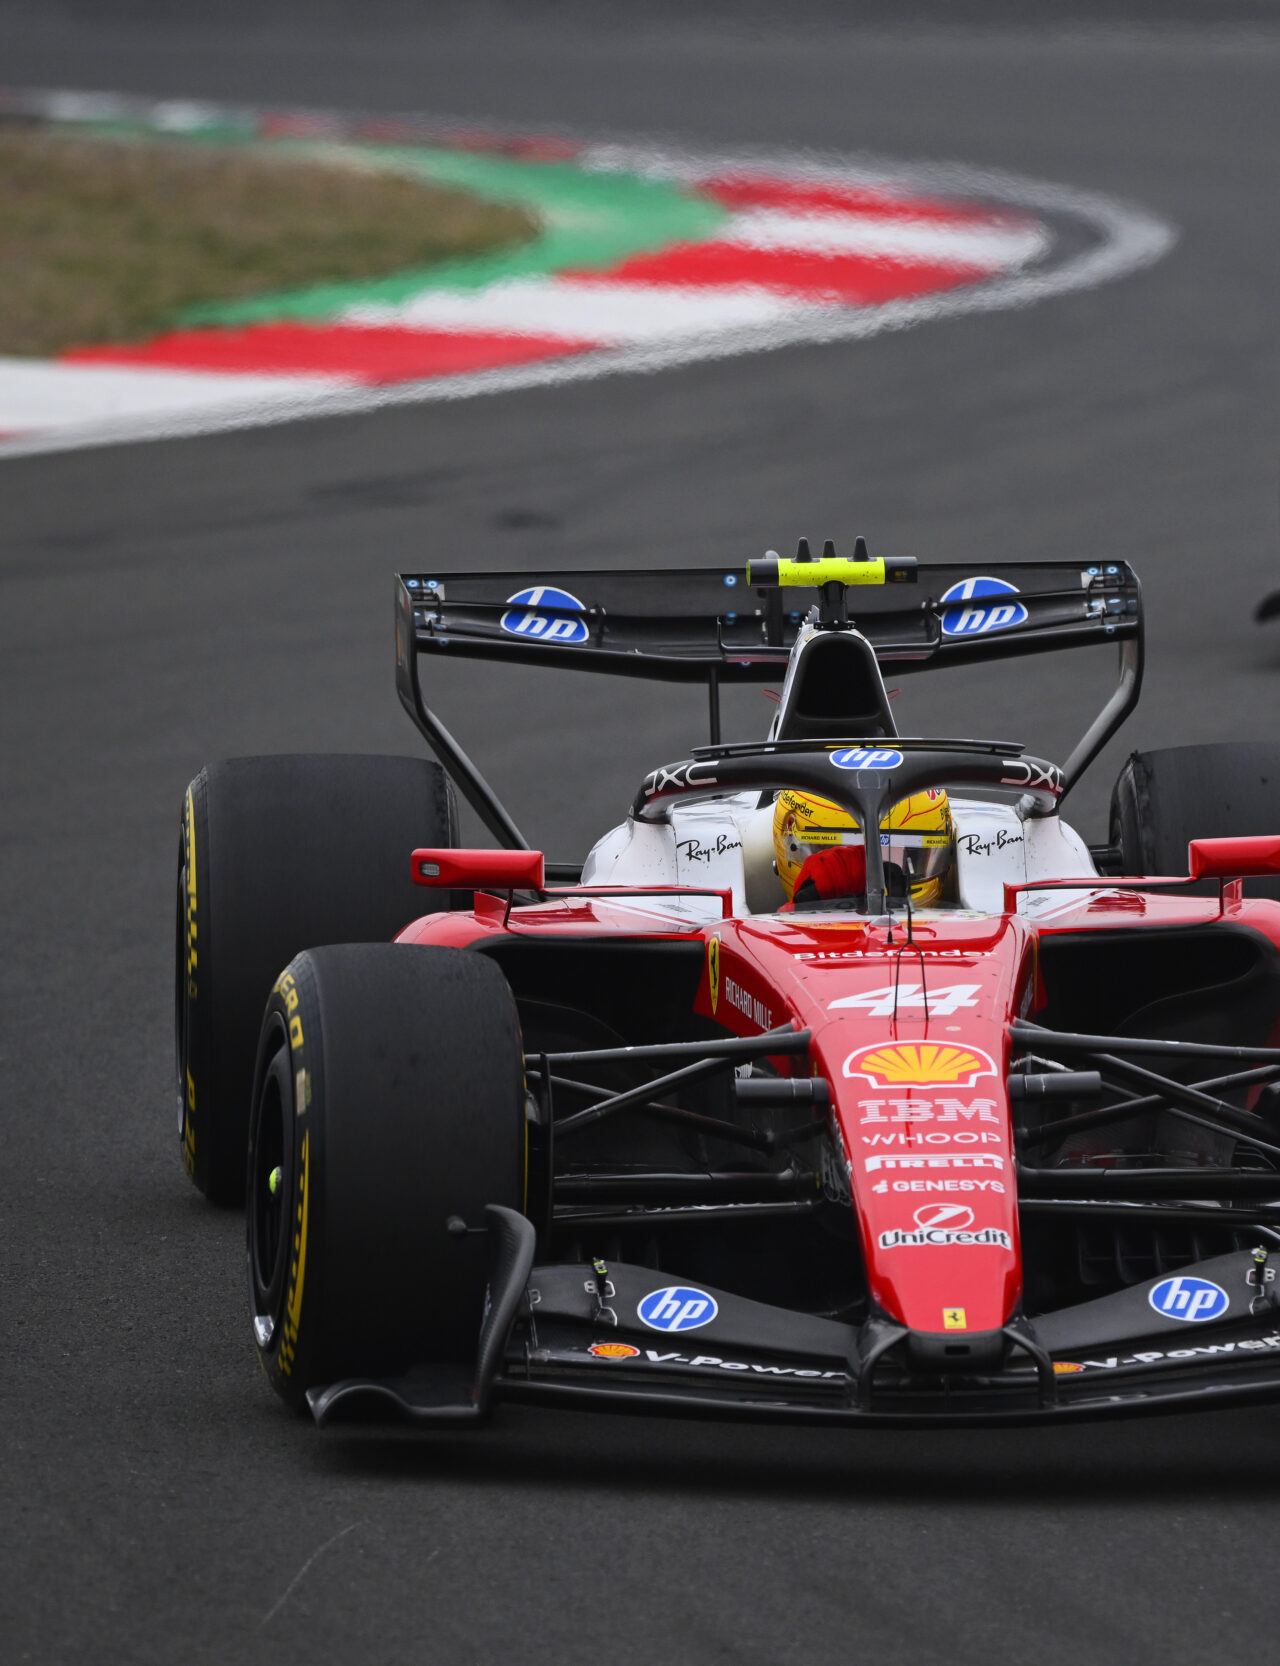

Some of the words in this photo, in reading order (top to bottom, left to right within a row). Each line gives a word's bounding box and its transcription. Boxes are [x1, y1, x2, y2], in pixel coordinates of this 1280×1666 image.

[514, 588, 578, 640] hp
[954, 579, 1016, 633] hp
[840, 747, 894, 769] hp
[676, 834, 743, 862] Ray-Ban
[957, 829, 1025, 856] Ray-Ban
[792, 949, 997, 961] Bitdefender
[725, 976, 752, 1019] RICHARD
[753, 998, 773, 1032] MILLE
[826, 983, 983, 1016] 44
[857, 1098, 1000, 1125] IBM
[861, 1132, 1001, 1146] WHOOP
[864, 1152, 1005, 1173] PIRELLI
[892, 1179, 1006, 1194] GENESYS
[880, 1229, 1011, 1248] UniCredit
[648, 1286, 709, 1331] hp
[1162, 1277, 1219, 1321] hp
[645, 1350, 848, 1379] V-Power
